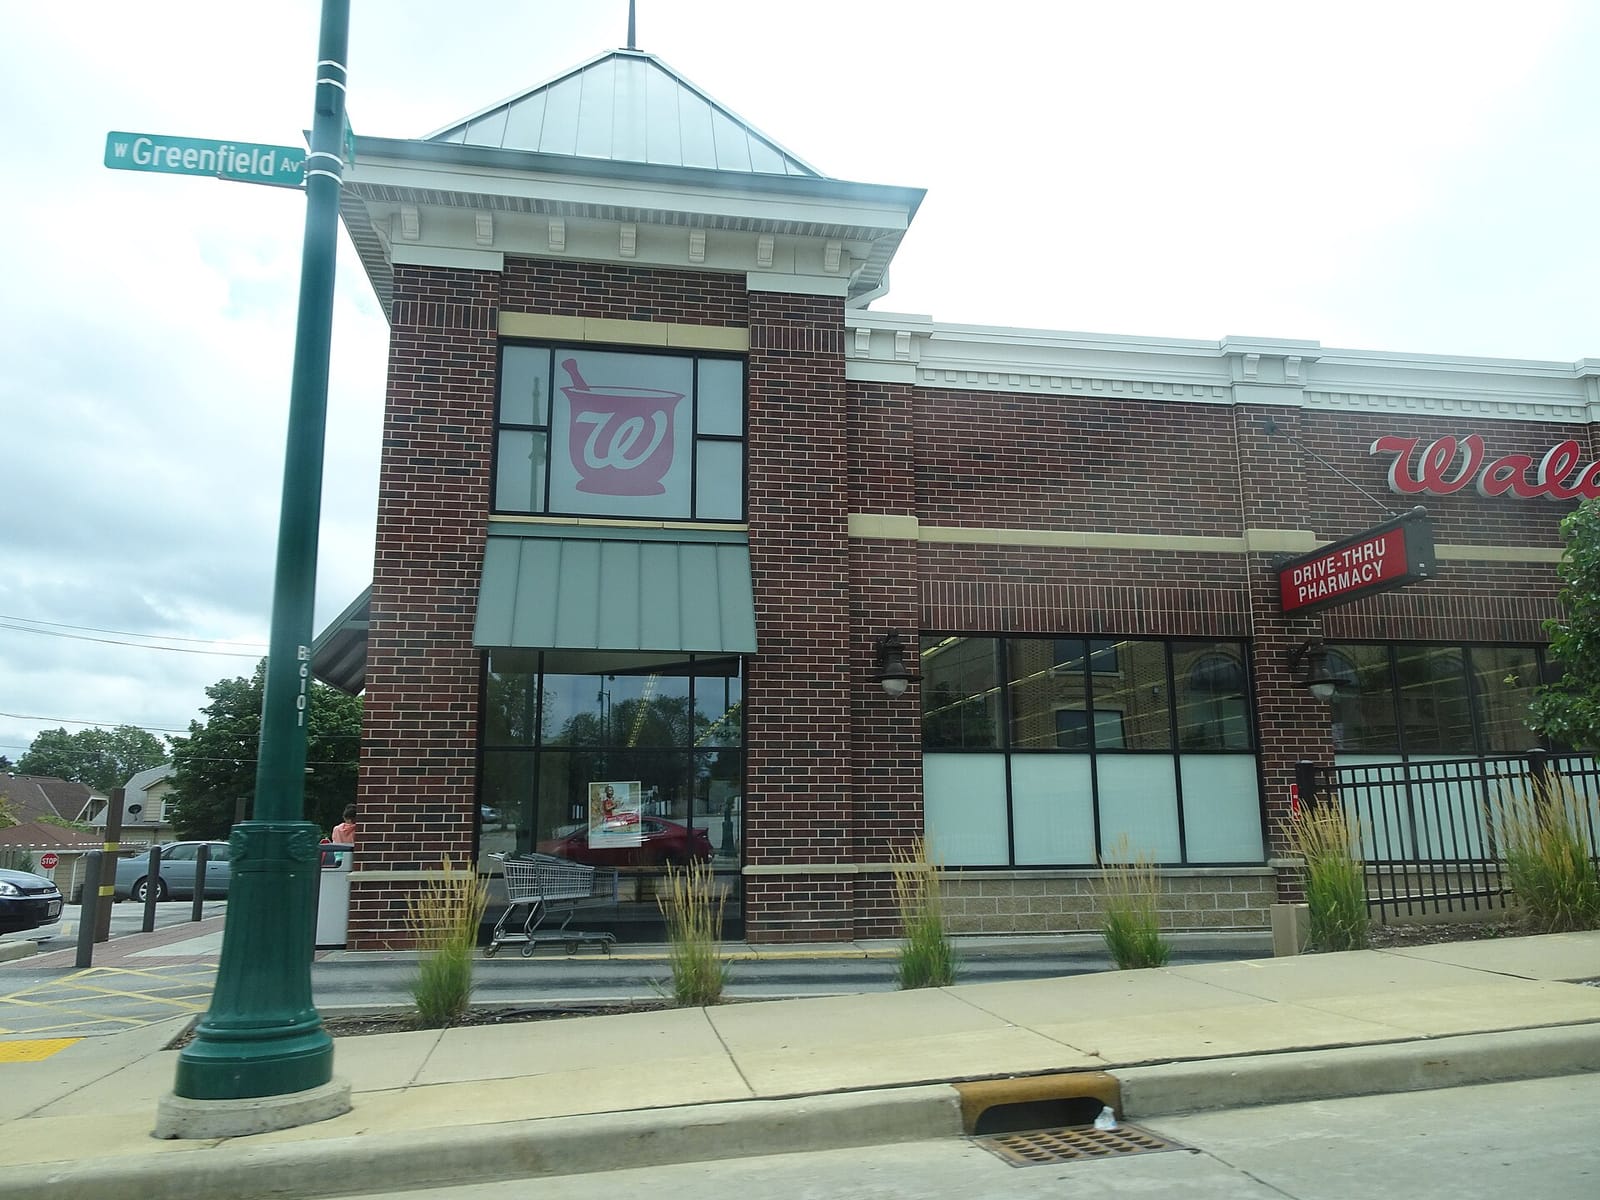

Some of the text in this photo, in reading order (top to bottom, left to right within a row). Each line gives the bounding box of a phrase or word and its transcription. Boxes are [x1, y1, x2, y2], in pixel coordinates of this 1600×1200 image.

[114, 137, 300, 176] W Greenfield Av
[575, 410, 668, 470] W
[1293, 538, 1386, 586] DRIVE-THRU
[1298, 560, 1384, 602] PHARMACY
[41, 857, 58, 865] STOP
